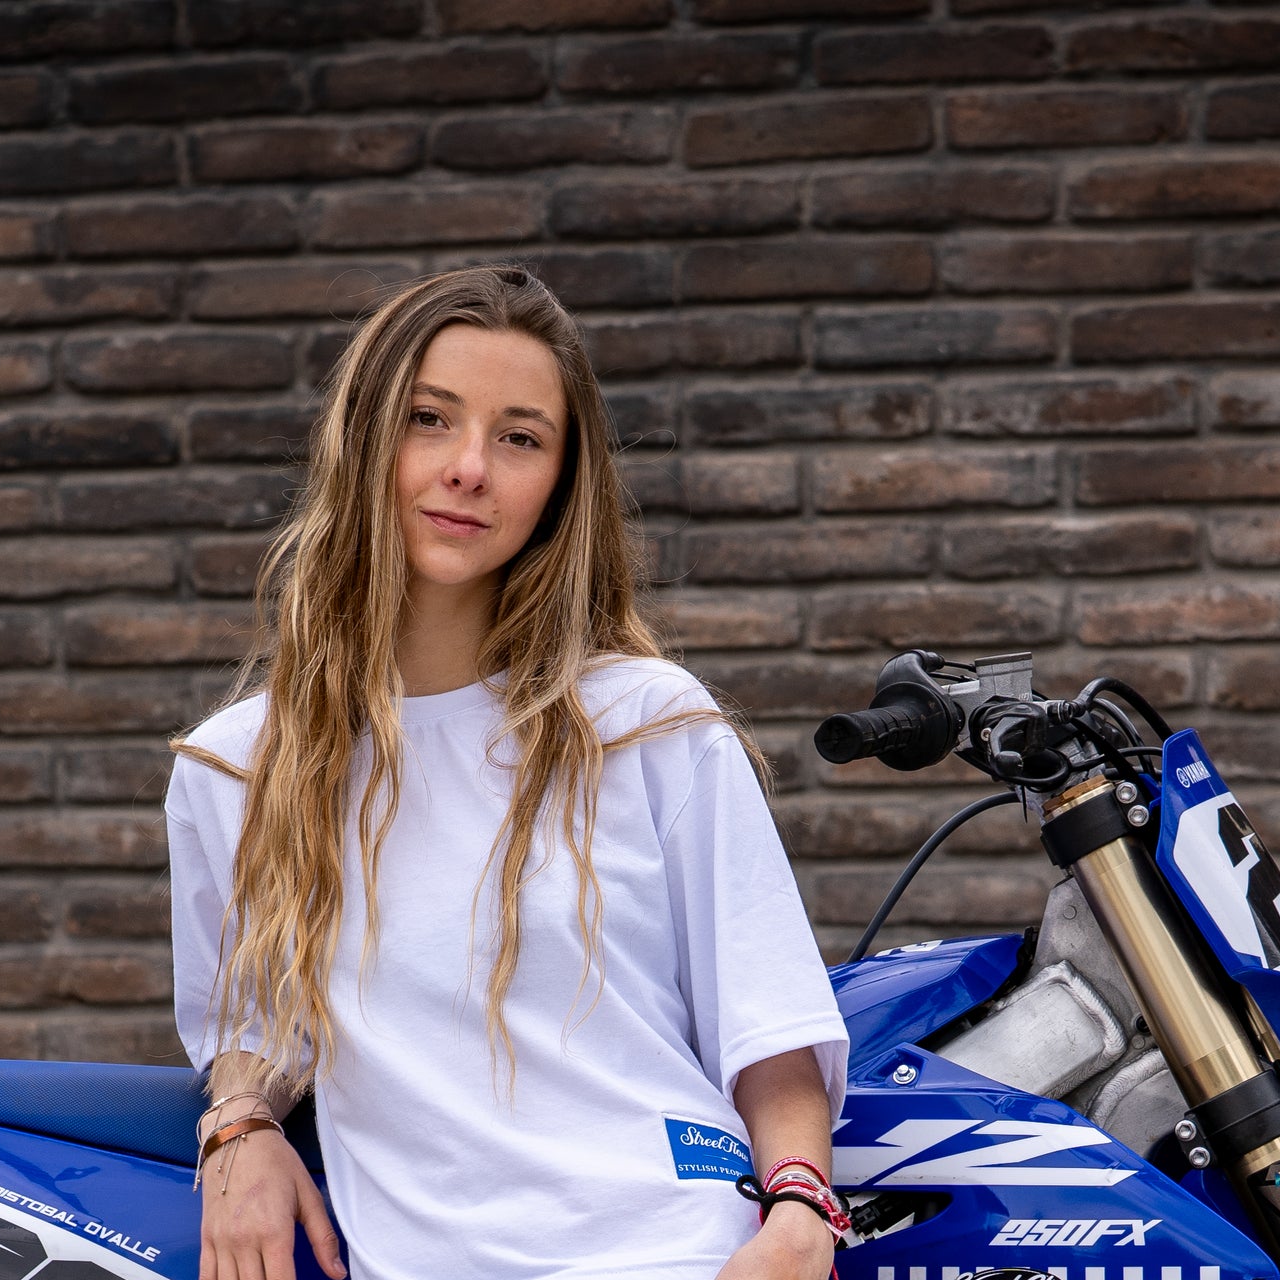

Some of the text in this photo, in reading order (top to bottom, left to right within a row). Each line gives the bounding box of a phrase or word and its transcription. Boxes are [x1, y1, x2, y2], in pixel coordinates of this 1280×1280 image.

[677, 1163, 718, 1173] STYLISH
[83, 1221, 161, 1262] OVALLE
[988, 1219, 1163, 1247] 250FX
